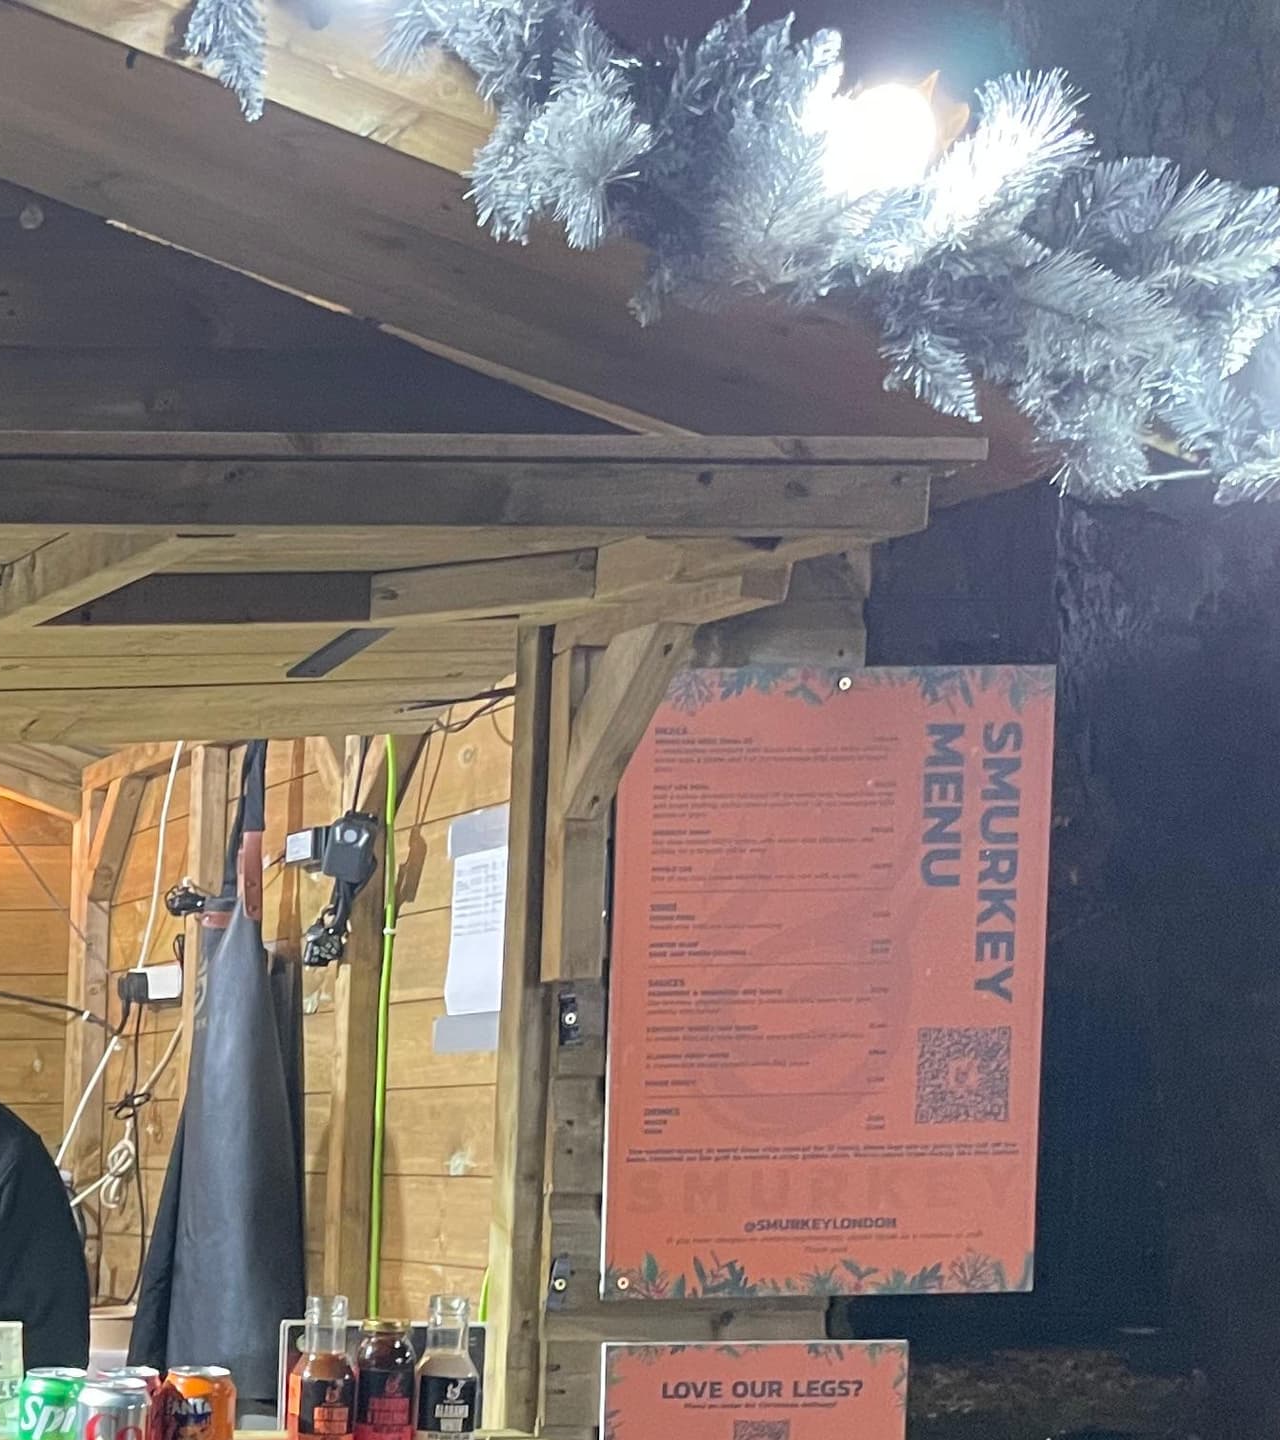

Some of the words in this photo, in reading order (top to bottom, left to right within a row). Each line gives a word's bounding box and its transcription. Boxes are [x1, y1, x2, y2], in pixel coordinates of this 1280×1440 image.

[920, 723, 966, 888] MENU
[974, 721, 1023, 1003] SMURKEY
[744, 1217, 898, 1234] @SMURKEYLONDON
[661, 1381, 723, 1400] LOVE
[732, 1380, 783, 1399] OUR
[793, 1379, 864, 1398] LEGS?
